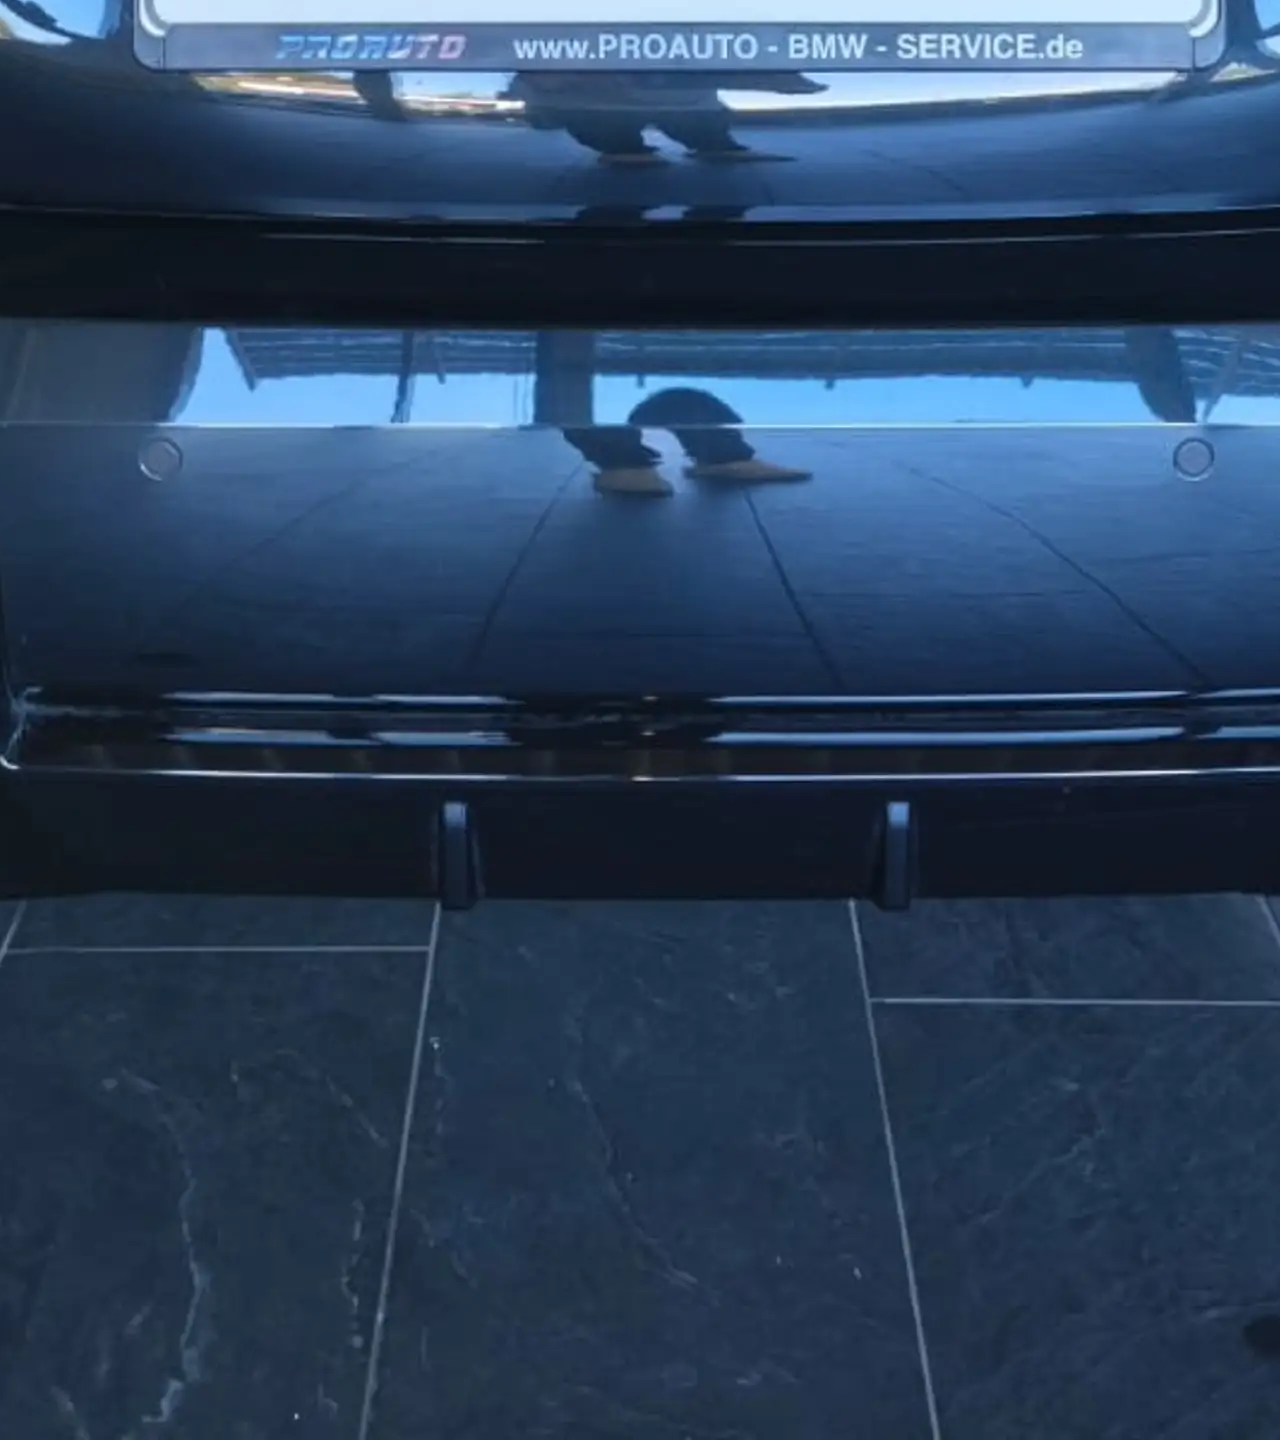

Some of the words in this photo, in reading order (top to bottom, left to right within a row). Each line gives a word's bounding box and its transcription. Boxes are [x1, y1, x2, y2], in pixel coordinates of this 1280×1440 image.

[275, 34, 468, 60] PROAUTO
[513, 33, 759, 60] www.PROAUTO
[788, 33, 868, 60] BMW
[896, 33, 1084, 60] SERVICE.de
